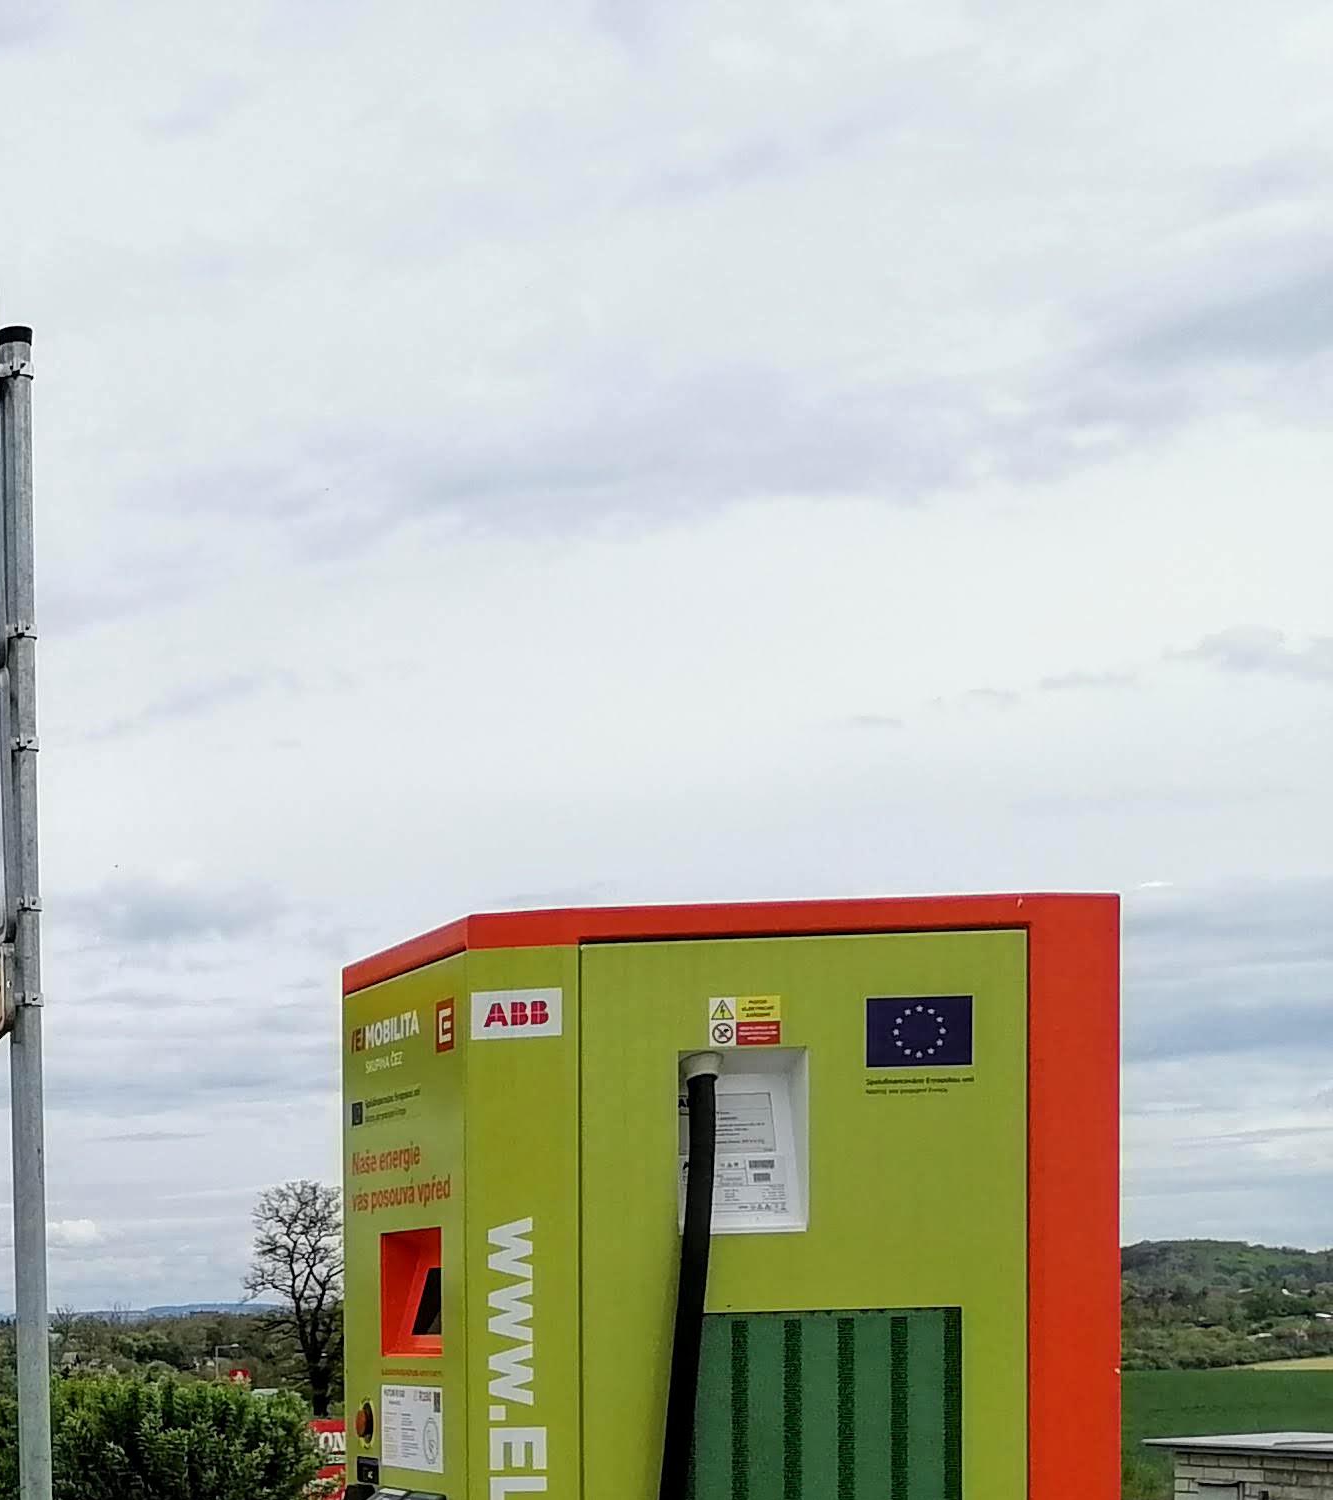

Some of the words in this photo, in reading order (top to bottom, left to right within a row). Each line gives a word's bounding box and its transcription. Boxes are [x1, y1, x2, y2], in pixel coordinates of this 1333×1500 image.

[484, 1000, 549, 1027] ABB
[379, 1141, 420, 1173] energie
[372, 1177, 414, 1214] posouvá
[418, 1174, 450, 1208] vpřed
